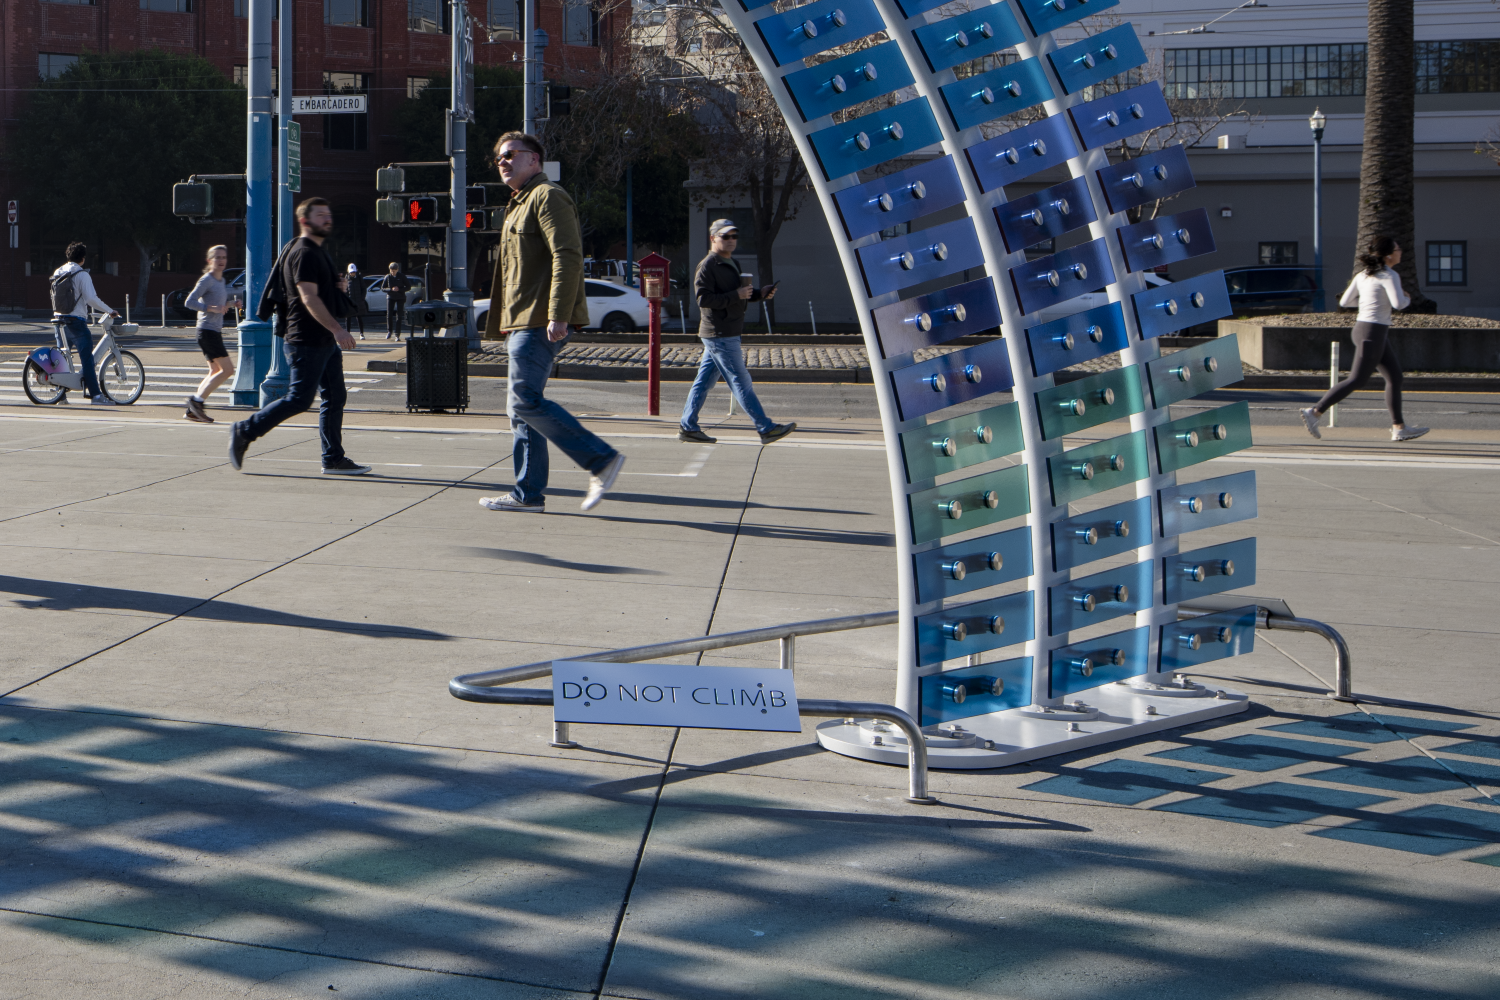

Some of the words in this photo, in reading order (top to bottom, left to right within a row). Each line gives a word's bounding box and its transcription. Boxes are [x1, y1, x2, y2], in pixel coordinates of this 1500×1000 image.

[300, 99, 360, 110] EMBARCADERO
[562, 681, 609, 701] DO
[618, 684, 682, 704] NOT
[691, 687, 788, 708] CLIMB
